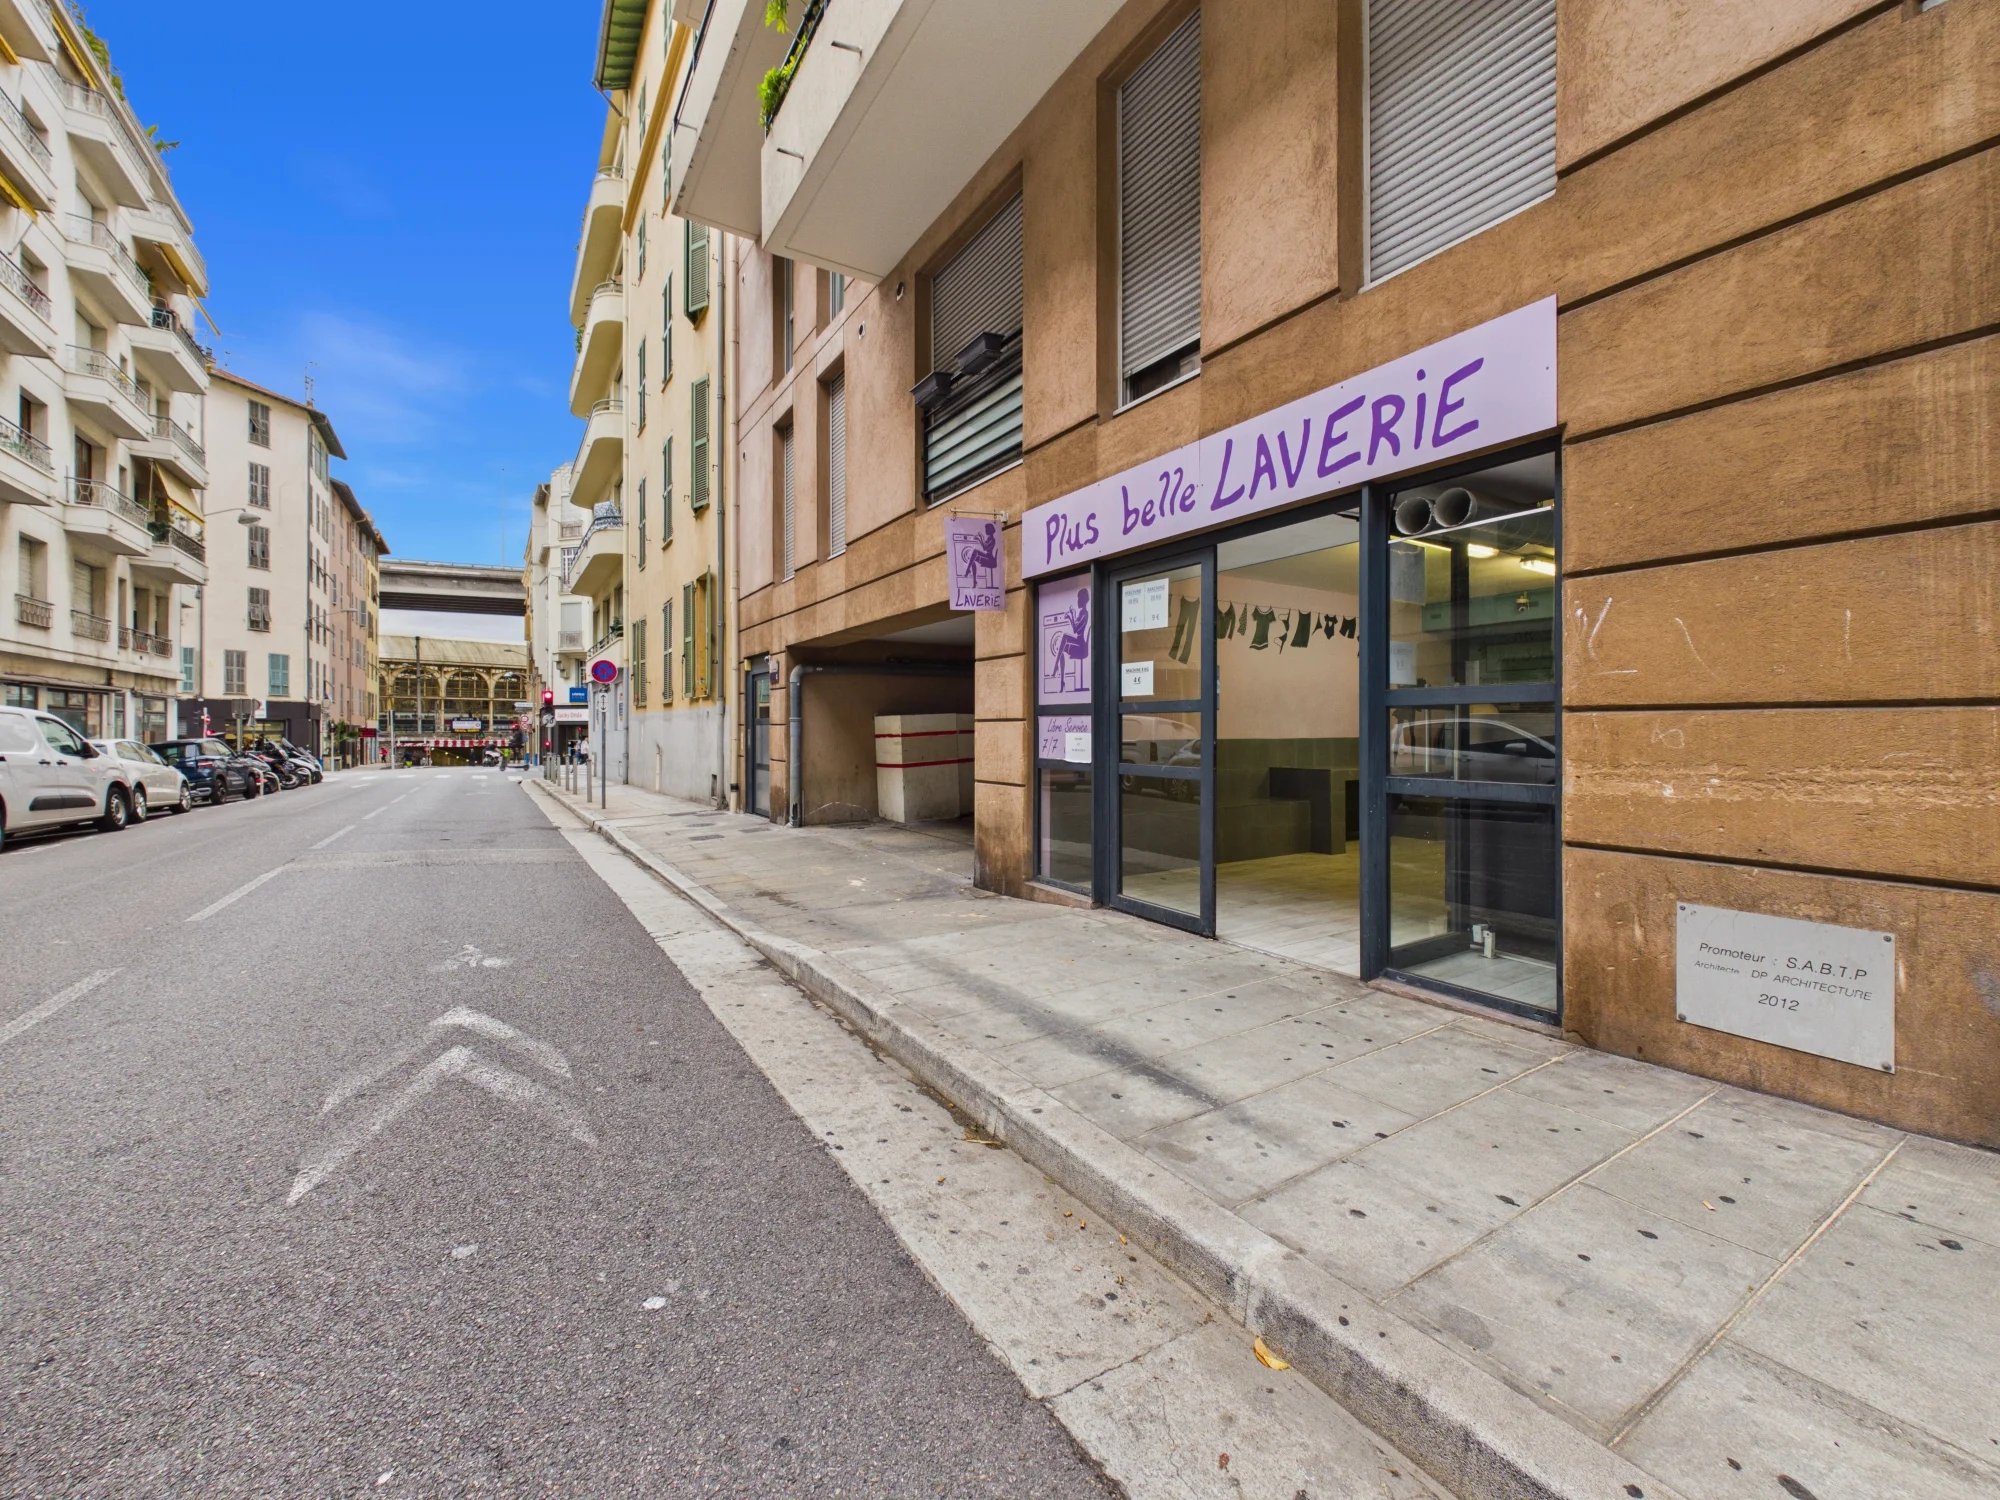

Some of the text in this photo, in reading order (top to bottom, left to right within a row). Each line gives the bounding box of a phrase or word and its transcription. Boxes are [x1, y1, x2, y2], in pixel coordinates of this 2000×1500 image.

[1045, 511, 1099, 566] Plus
[1120, 466, 1197, 536] belle
[1047, 717, 1089, 733] Libre Service
[1694, 959, 1873, 1002] Architecte DP ARCHITECTURE
[1698, 942, 1766, 964] Promoteur
[1786, 956, 1868, 981] S.A.B.T.P
[1757, 993, 1801, 1012] 2012
